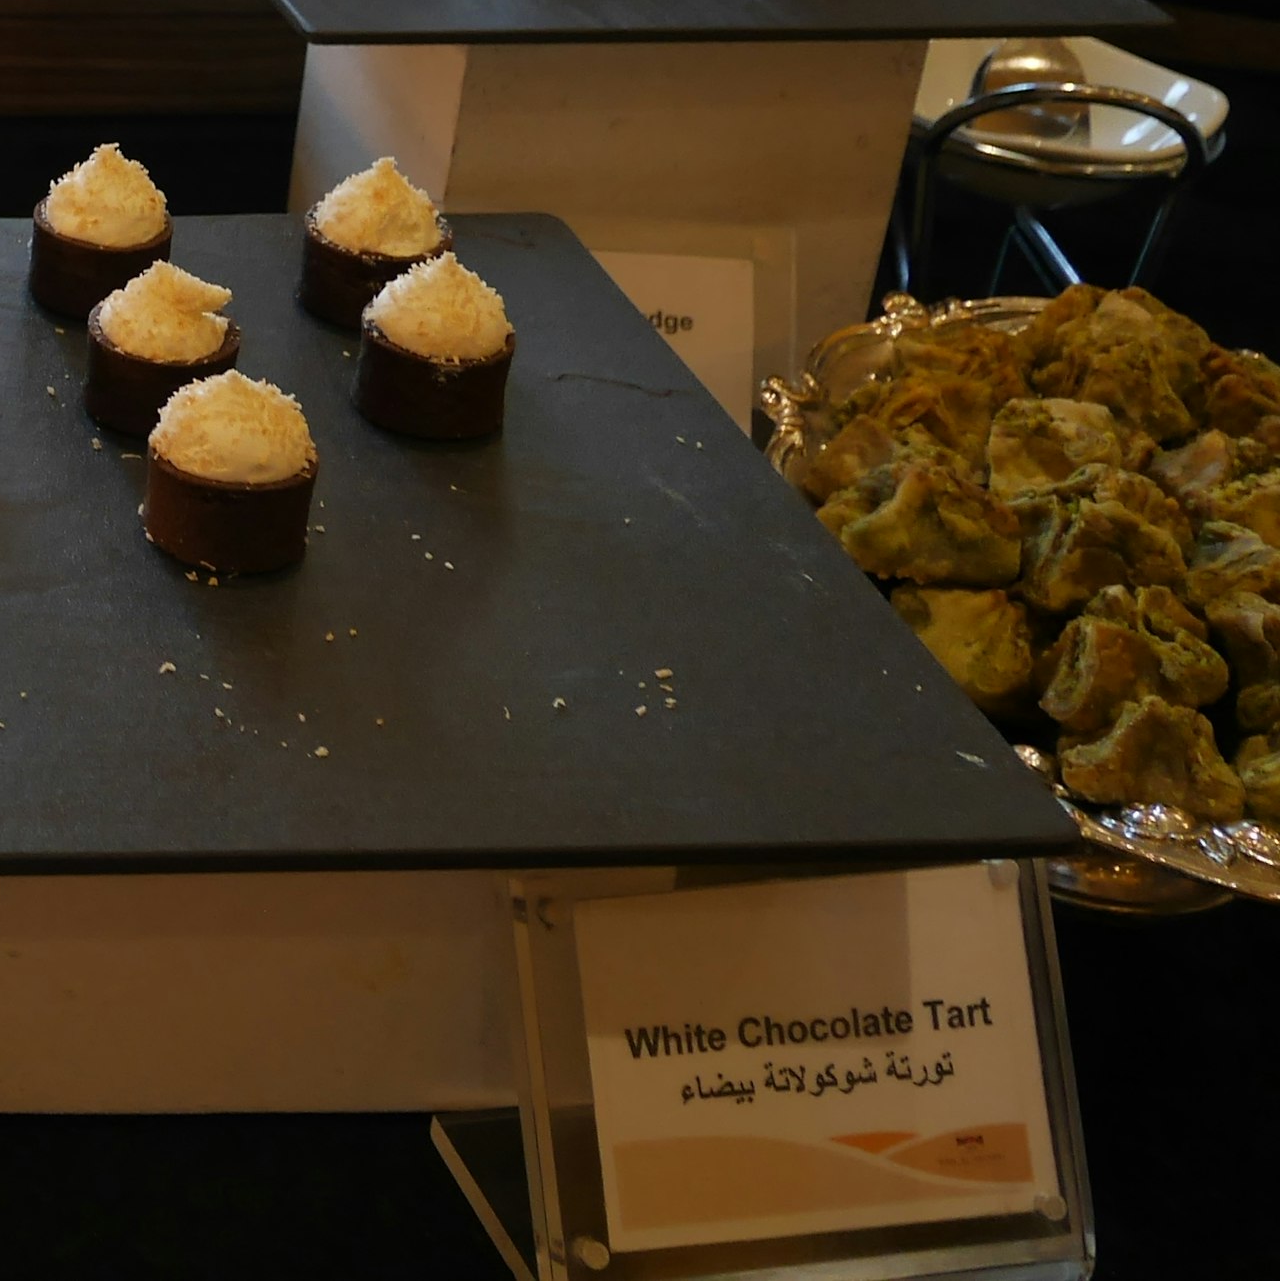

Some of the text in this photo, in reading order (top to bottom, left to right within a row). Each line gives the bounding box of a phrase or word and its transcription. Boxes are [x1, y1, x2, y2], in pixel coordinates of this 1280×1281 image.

[646, 309, 694, 336] dge
[624, 997, 994, 1060] White Chocolate Tart
[680, 1051, 956, 1106] تورتة شوكولاتة بيضاء
